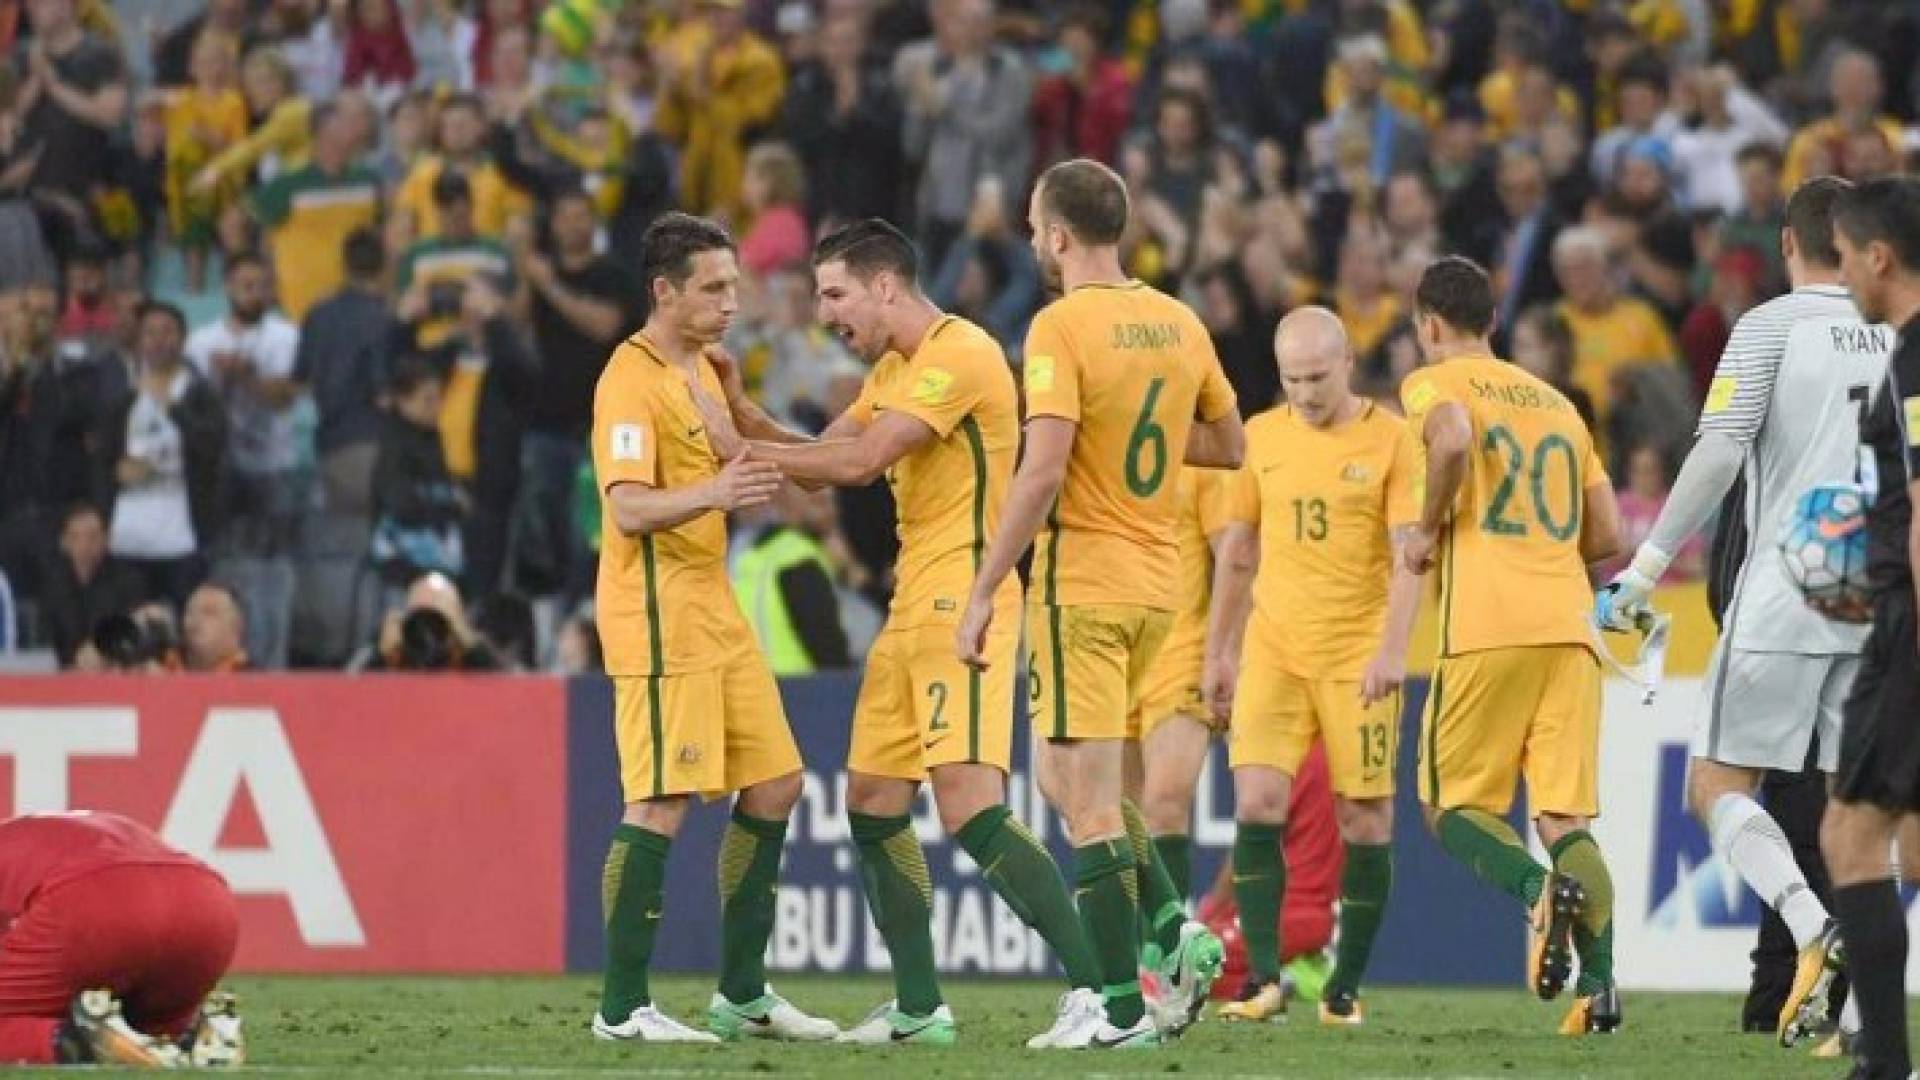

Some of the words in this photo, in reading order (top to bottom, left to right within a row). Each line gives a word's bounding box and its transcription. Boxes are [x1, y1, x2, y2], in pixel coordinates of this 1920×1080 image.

[1111, 323, 1182, 349] JURMAN
[1830, 326, 1887, 353] RYAN
[1124, 376, 1168, 498] 6
[1480, 425, 1579, 542] 20
[1291, 498, 1328, 541] 13
[926, 682, 949, 731] 2
[1358, 722, 1387, 768] 13
[763, 886, 853, 970] BU
